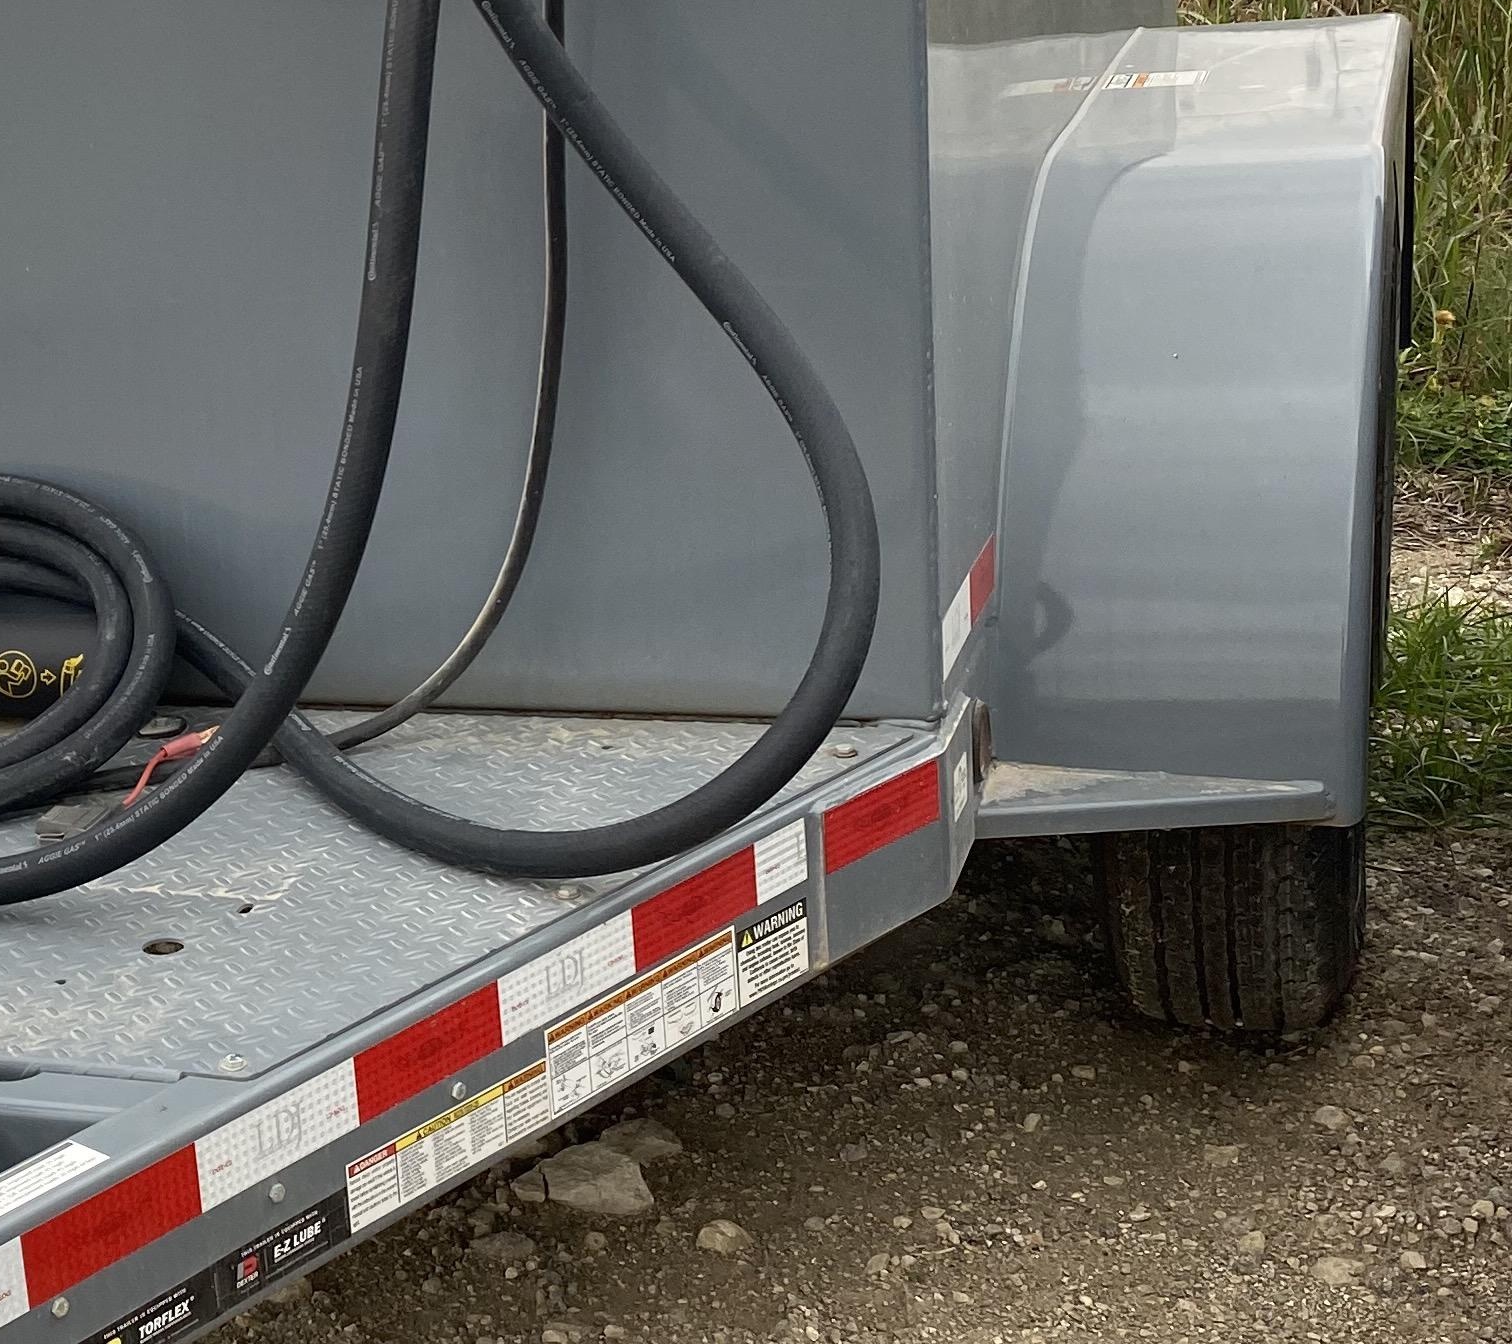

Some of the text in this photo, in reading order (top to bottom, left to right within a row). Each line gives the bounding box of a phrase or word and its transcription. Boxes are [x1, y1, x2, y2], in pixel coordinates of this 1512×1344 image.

[263, 633, 289, 676] Continental
[333, 464, 345, 499] STATIC
[340, 424, 353, 465] BONDED
[348, 398, 357, 424] Made
[354, 366, 363, 386] USA
[38, 850, 62, 864] AGGIE
[135, 797, 160, 818] STATIC
[159, 773, 188, 799] BONDED
[187, 757, 204, 775] Made
[209, 735, 224, 751] USA
[752, 901, 803, 940] WARNING
[250, 1097, 304, 1156] LDJ
[360, 1149, 388, 1169] DANGER
[423, 1115, 452, 1134] CAUTION
[273, 1238, 291, 1258] E-Z
[236, 1271, 259, 1289] DEXTER
